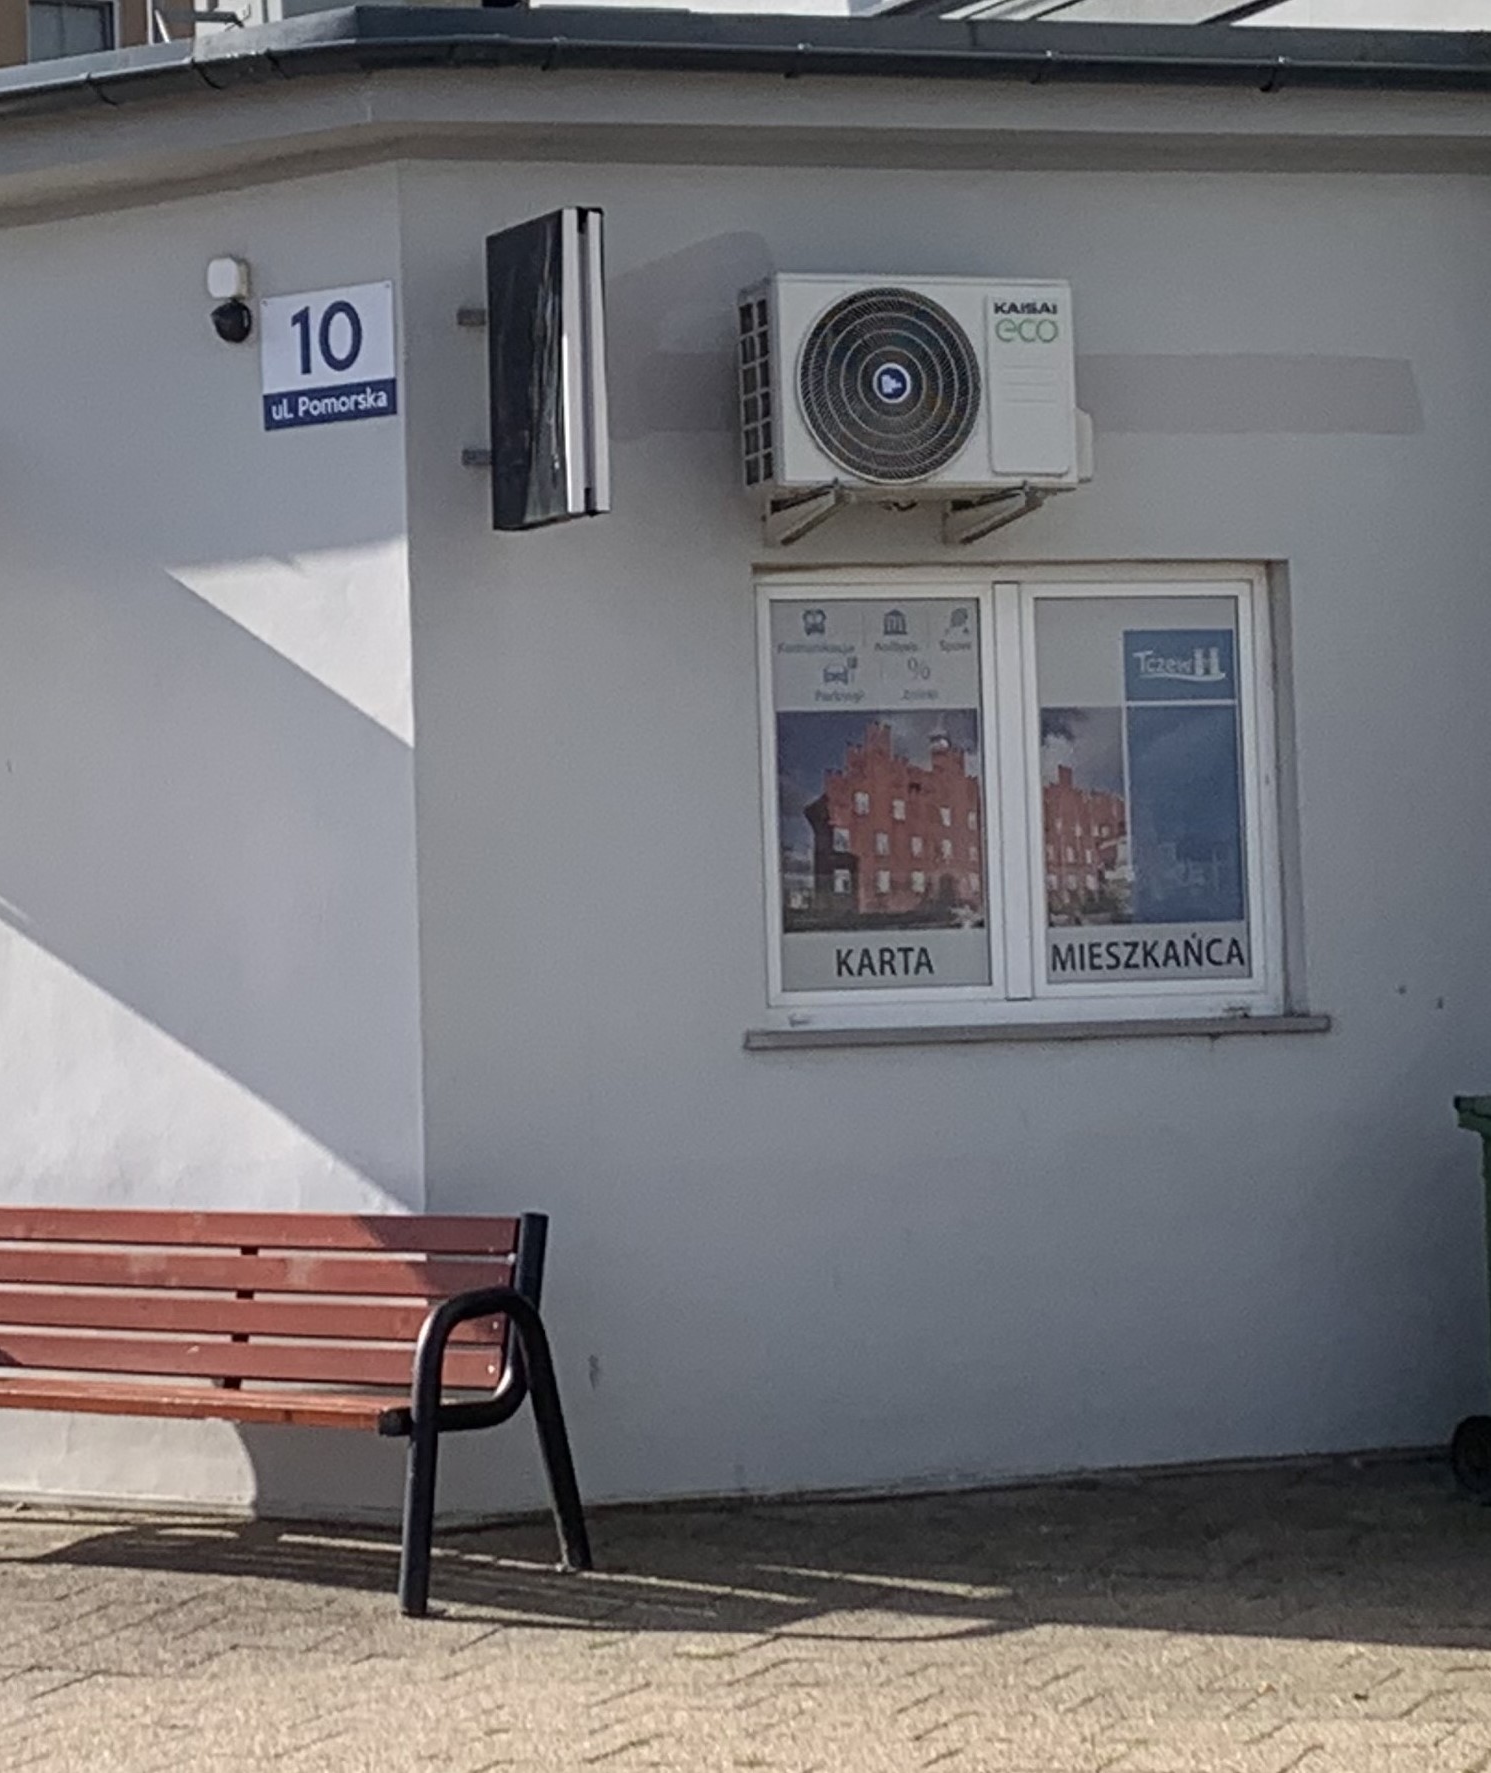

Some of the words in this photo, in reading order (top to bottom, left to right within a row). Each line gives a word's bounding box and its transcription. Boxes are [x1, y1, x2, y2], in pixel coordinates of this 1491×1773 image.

[993, 302, 1058, 315] KAISAI
[290, 300, 363, 375] 10
[995, 318, 1059, 343] eco
[271, 398, 294, 420] ul.
[297, 387, 388, 417] Pomorska
[1133, 650, 1193, 674] Tczew
[835, 947, 935, 977] KARTA
[1051, 932, 1245, 972] MIESZKAŃCA
